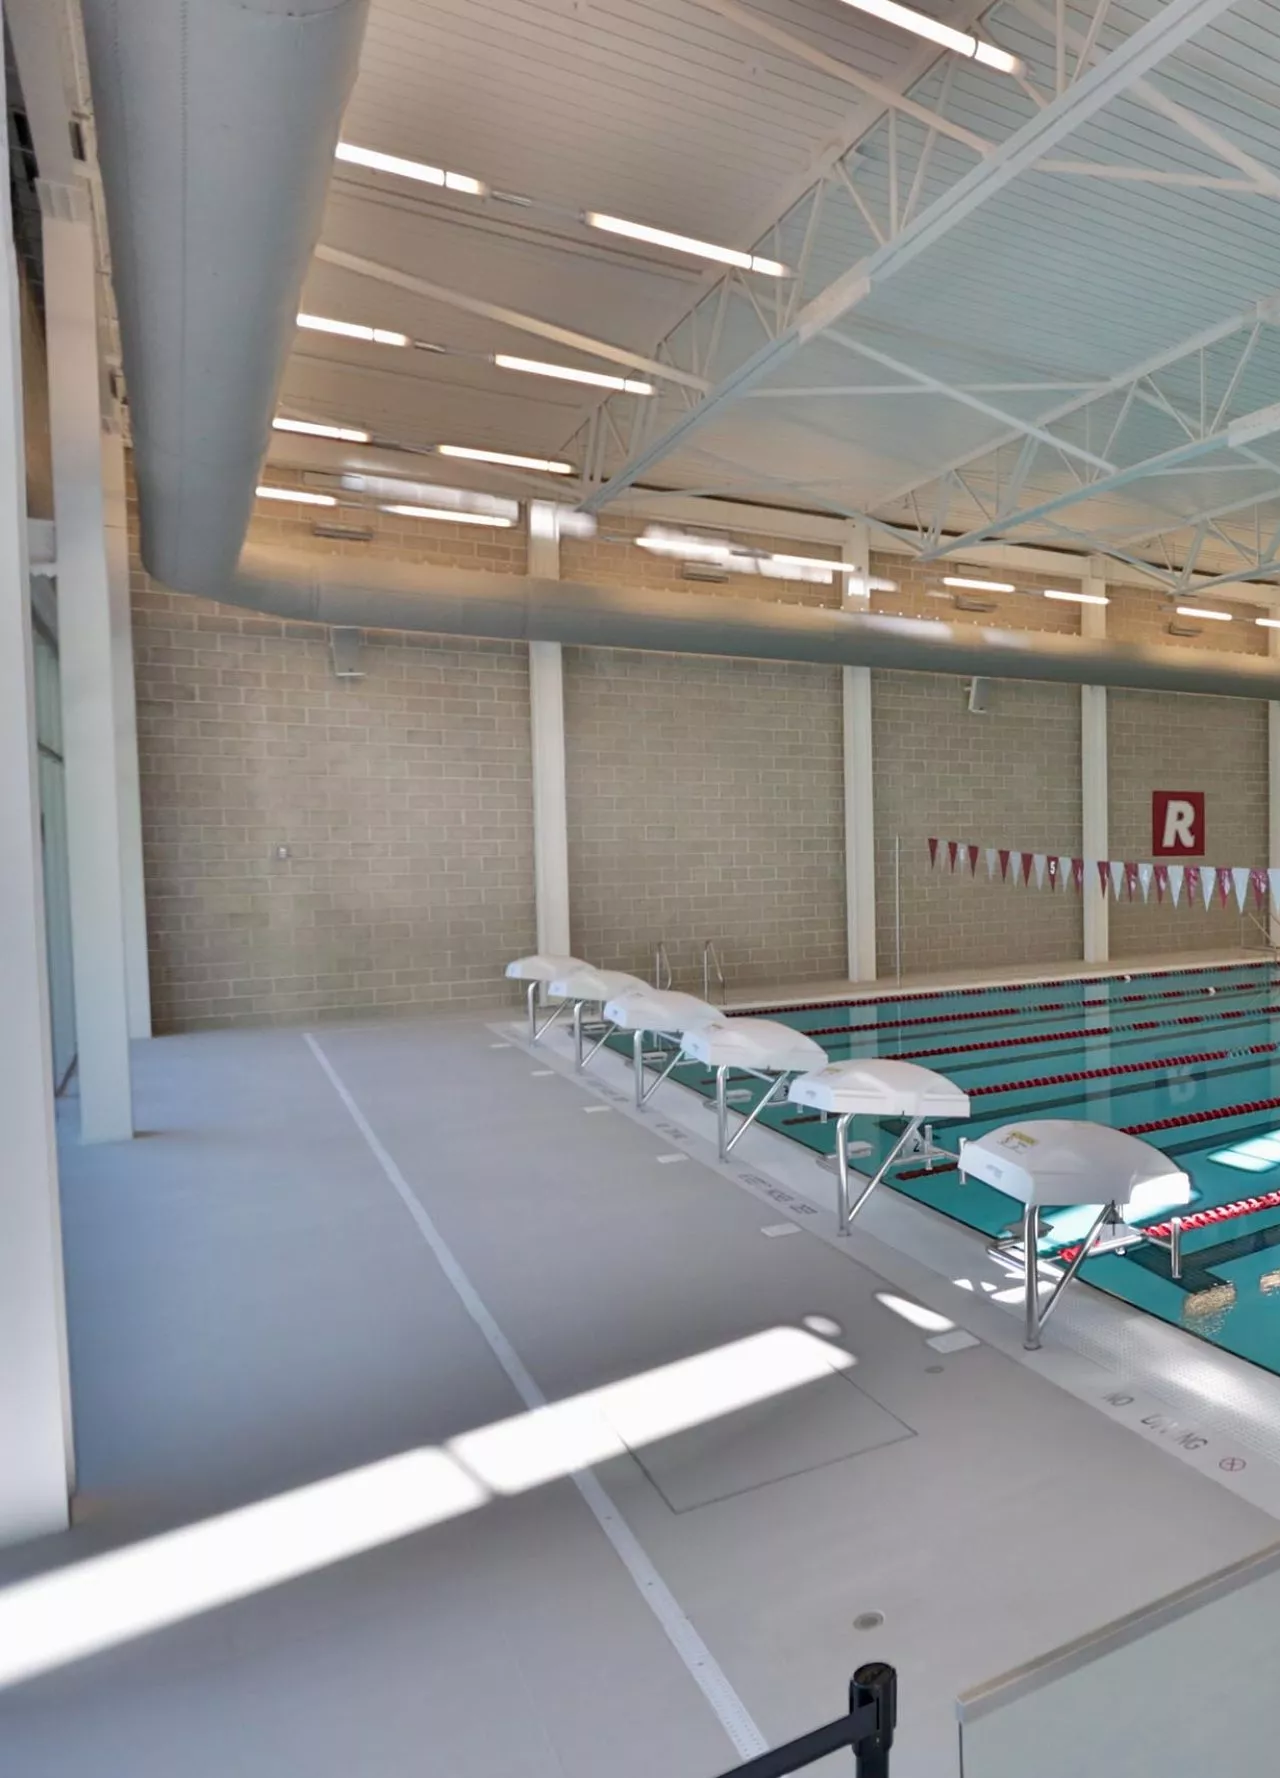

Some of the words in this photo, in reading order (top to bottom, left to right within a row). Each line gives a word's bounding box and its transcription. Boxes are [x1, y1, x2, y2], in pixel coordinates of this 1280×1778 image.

[1162, 800, 1195, 848] R
[1049, 861, 1056, 874] 5
[913, 1138, 920, 1152] 2
